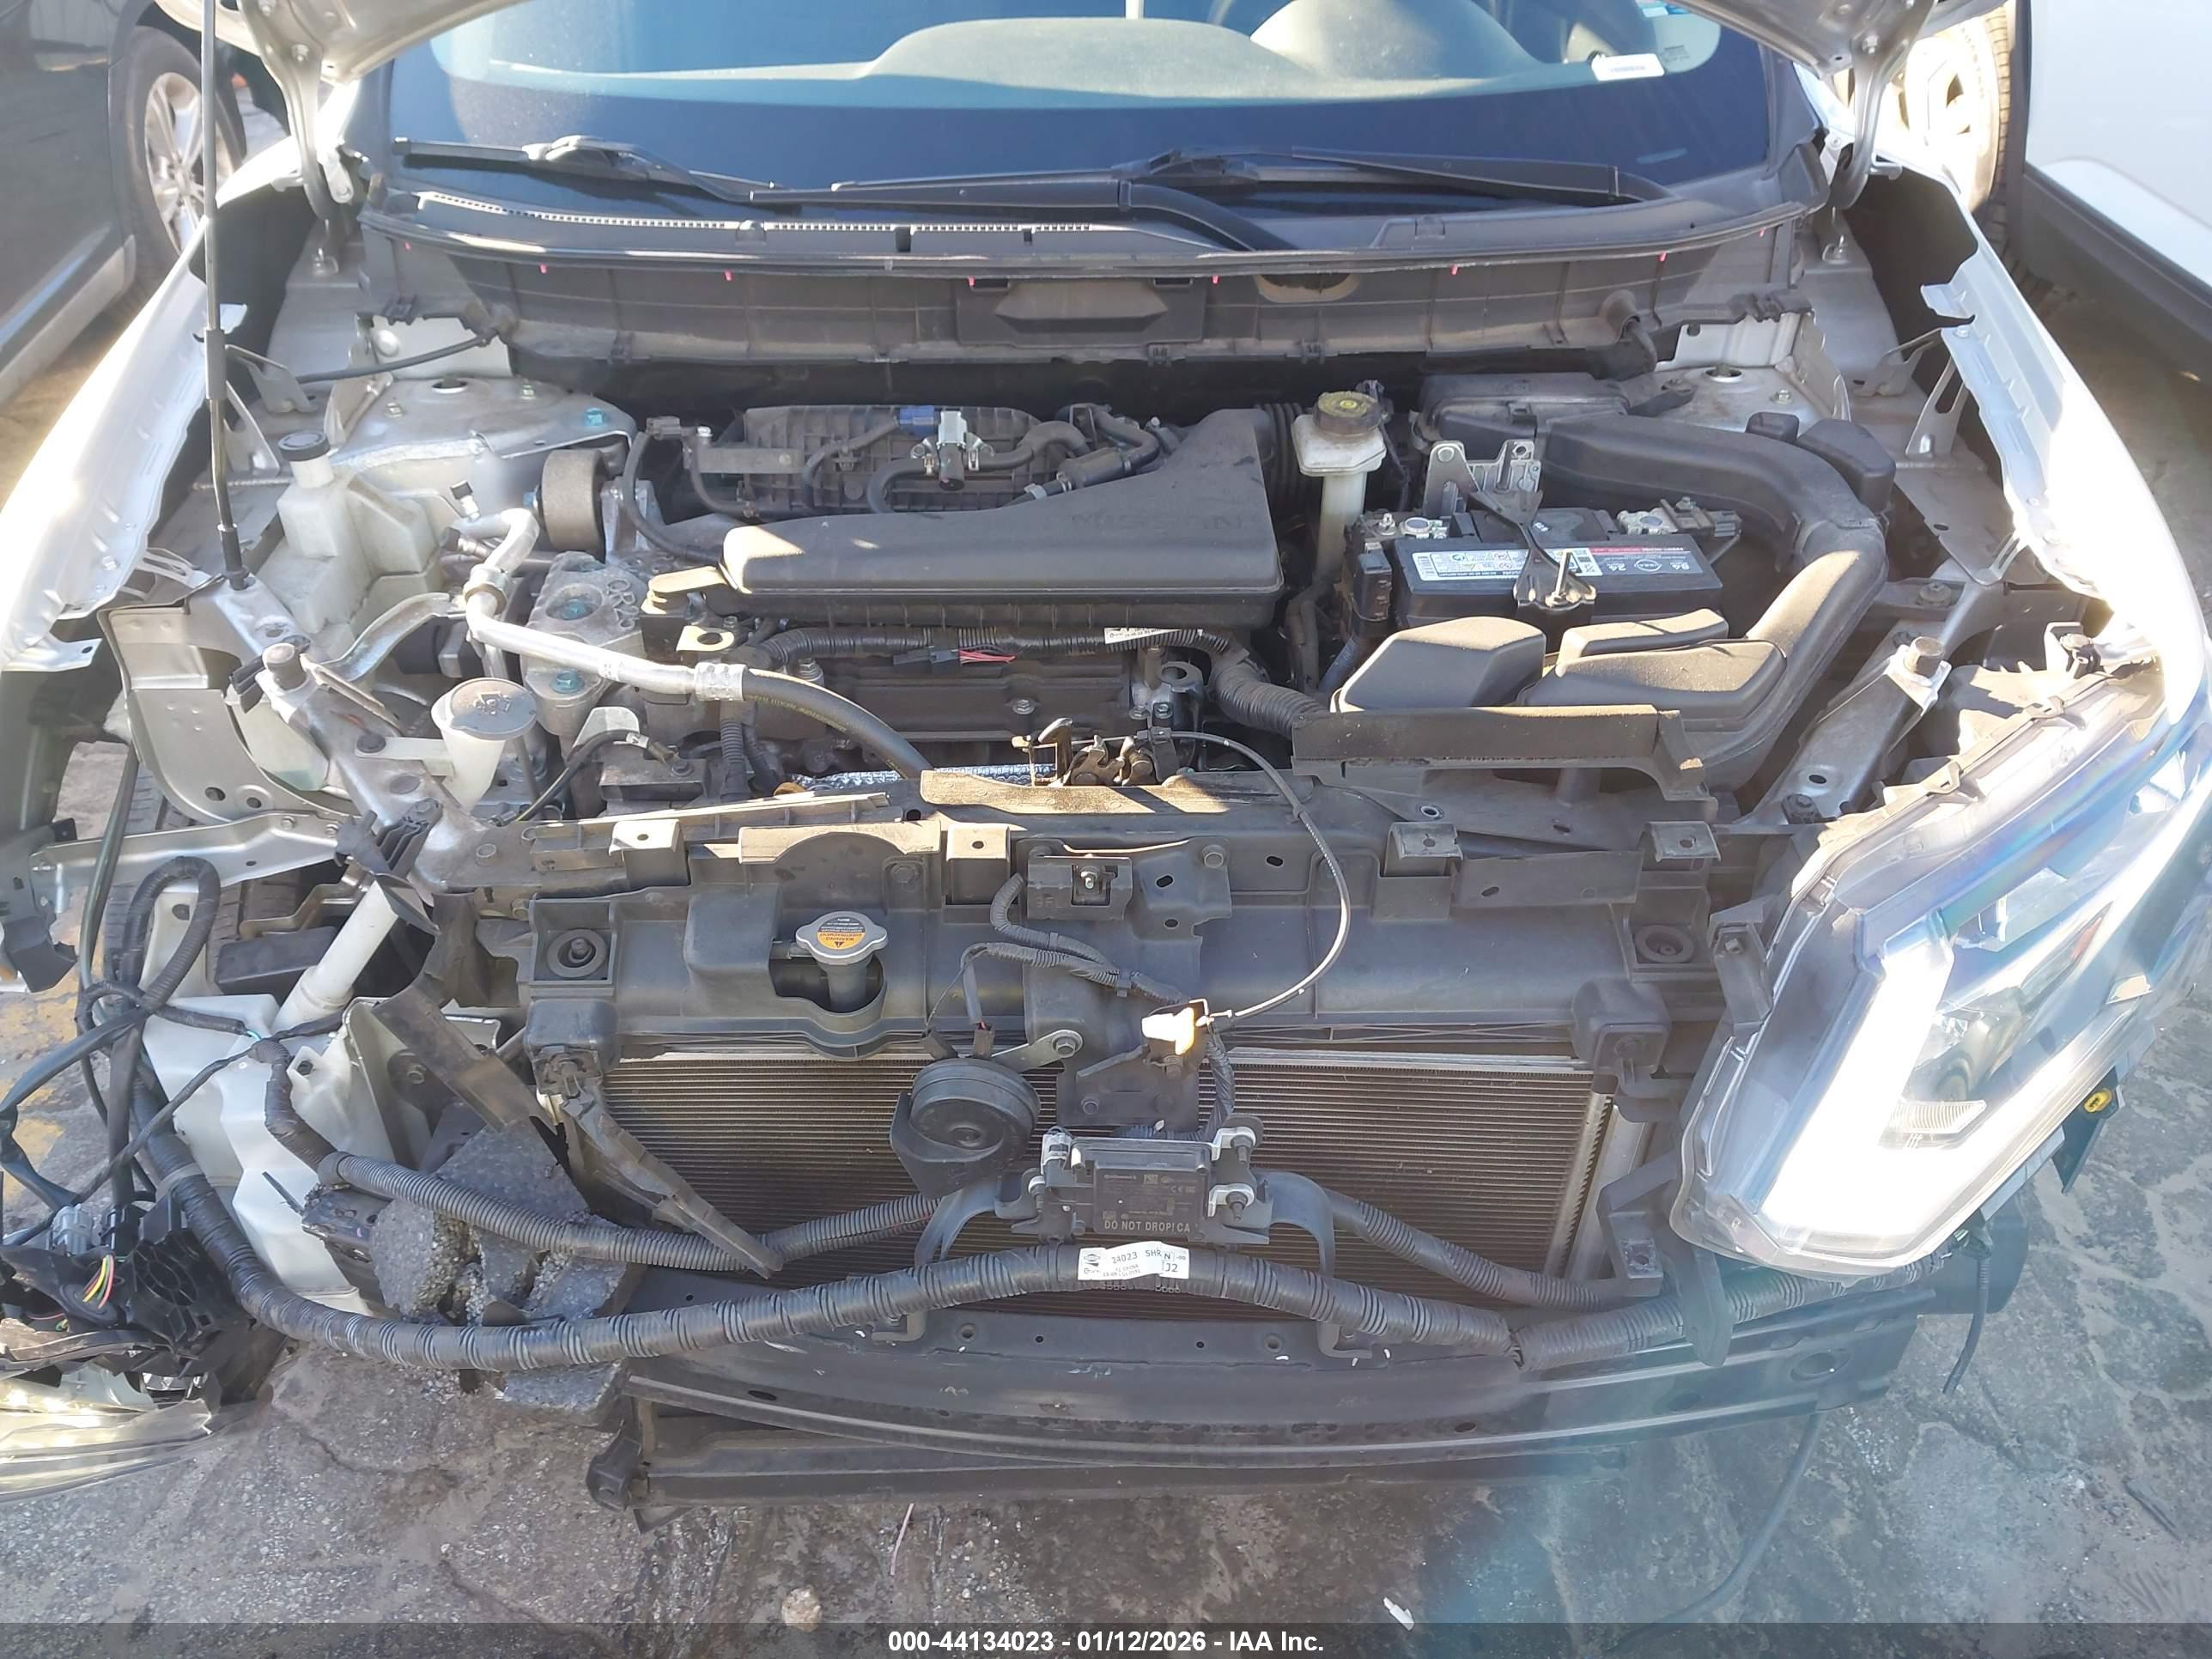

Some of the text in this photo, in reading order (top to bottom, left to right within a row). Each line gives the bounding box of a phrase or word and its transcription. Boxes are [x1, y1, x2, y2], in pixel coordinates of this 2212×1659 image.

[1104, 1219, 1118, 1231] DO
[1121, 1220, 1142, 1231] NOT
[1111, 1252, 1138, 1263] 24023
